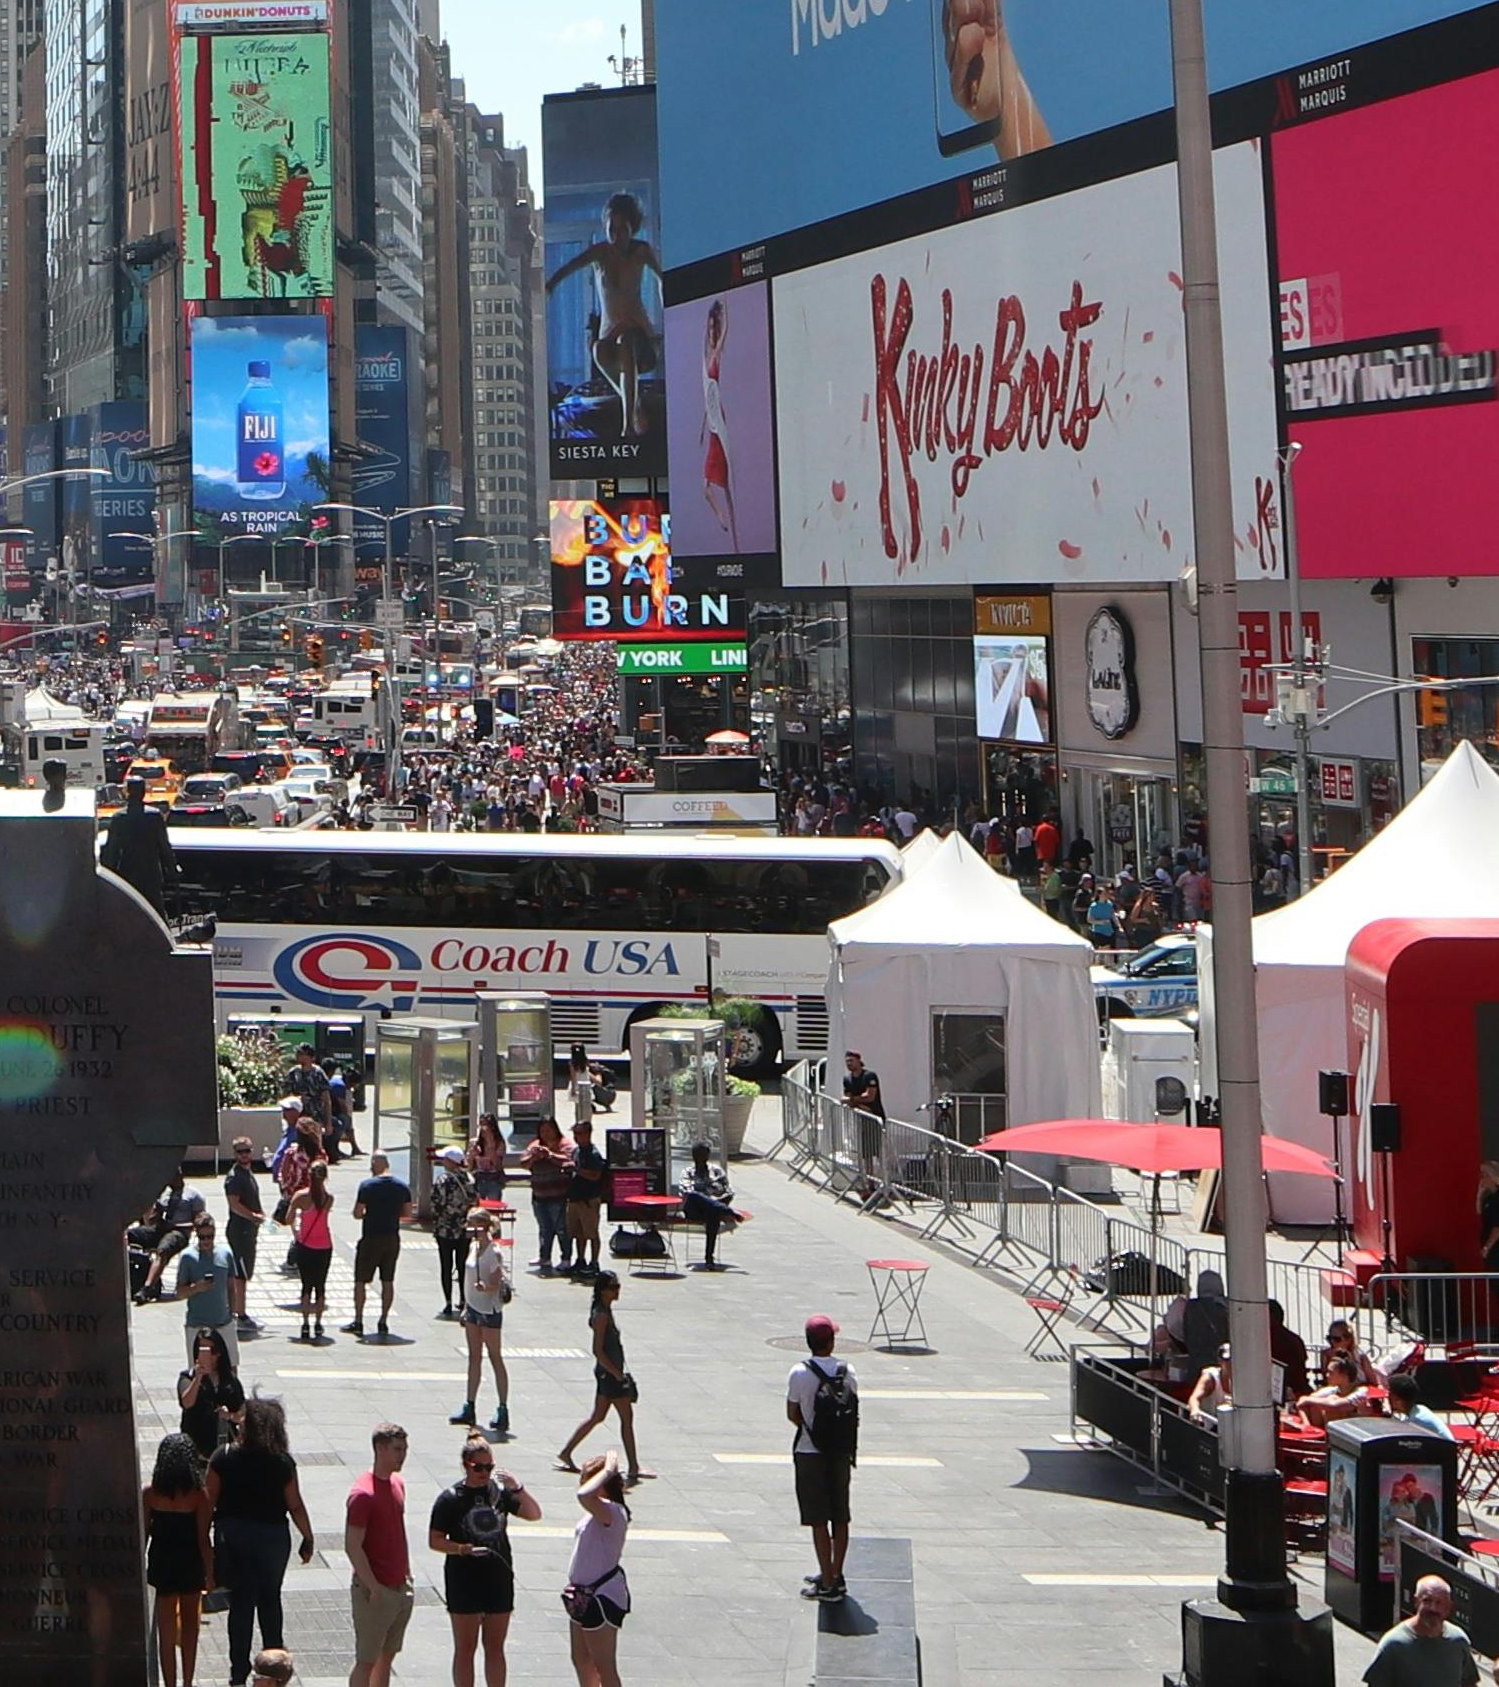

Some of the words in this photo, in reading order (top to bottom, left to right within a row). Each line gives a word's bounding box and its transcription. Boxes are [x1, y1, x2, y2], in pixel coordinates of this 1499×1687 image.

[1298, 60, 1351, 89] MARRIOTT
[1300, 84, 1347, 112] MARQUIS
[972, 169, 1007, 191] MARRIOTT
[973, 187, 1004, 208] MARQUIS
[244, 415, 277, 440] FIJI
[871, 273, 984, 563] Kinky
[983, 279, 1105, 457] Boots
[558, 446, 606, 459] SIESTA
[612, 443, 640, 459] KEY
[221, 512, 239, 523] AS
[241, 511, 303, 523] TROPICAL
[246, 522, 278, 534] RAIN
[585, 594, 729, 627] BURN
[630, 650, 683, 666] YORK
[430, 936, 569, 974] Coach
[582, 939, 682, 976] USA
[6, 995, 109, 1015] COLONEL
[25, 1024, 129, 1052] DUFFY
[16, 1096, 93, 1115] PRIEST
[2, 1182, 95, 1202] INFANTRY
[9, 1269, 96, 1288] SERVICE
[0, 1314, 101, 1333] COUNTRY
